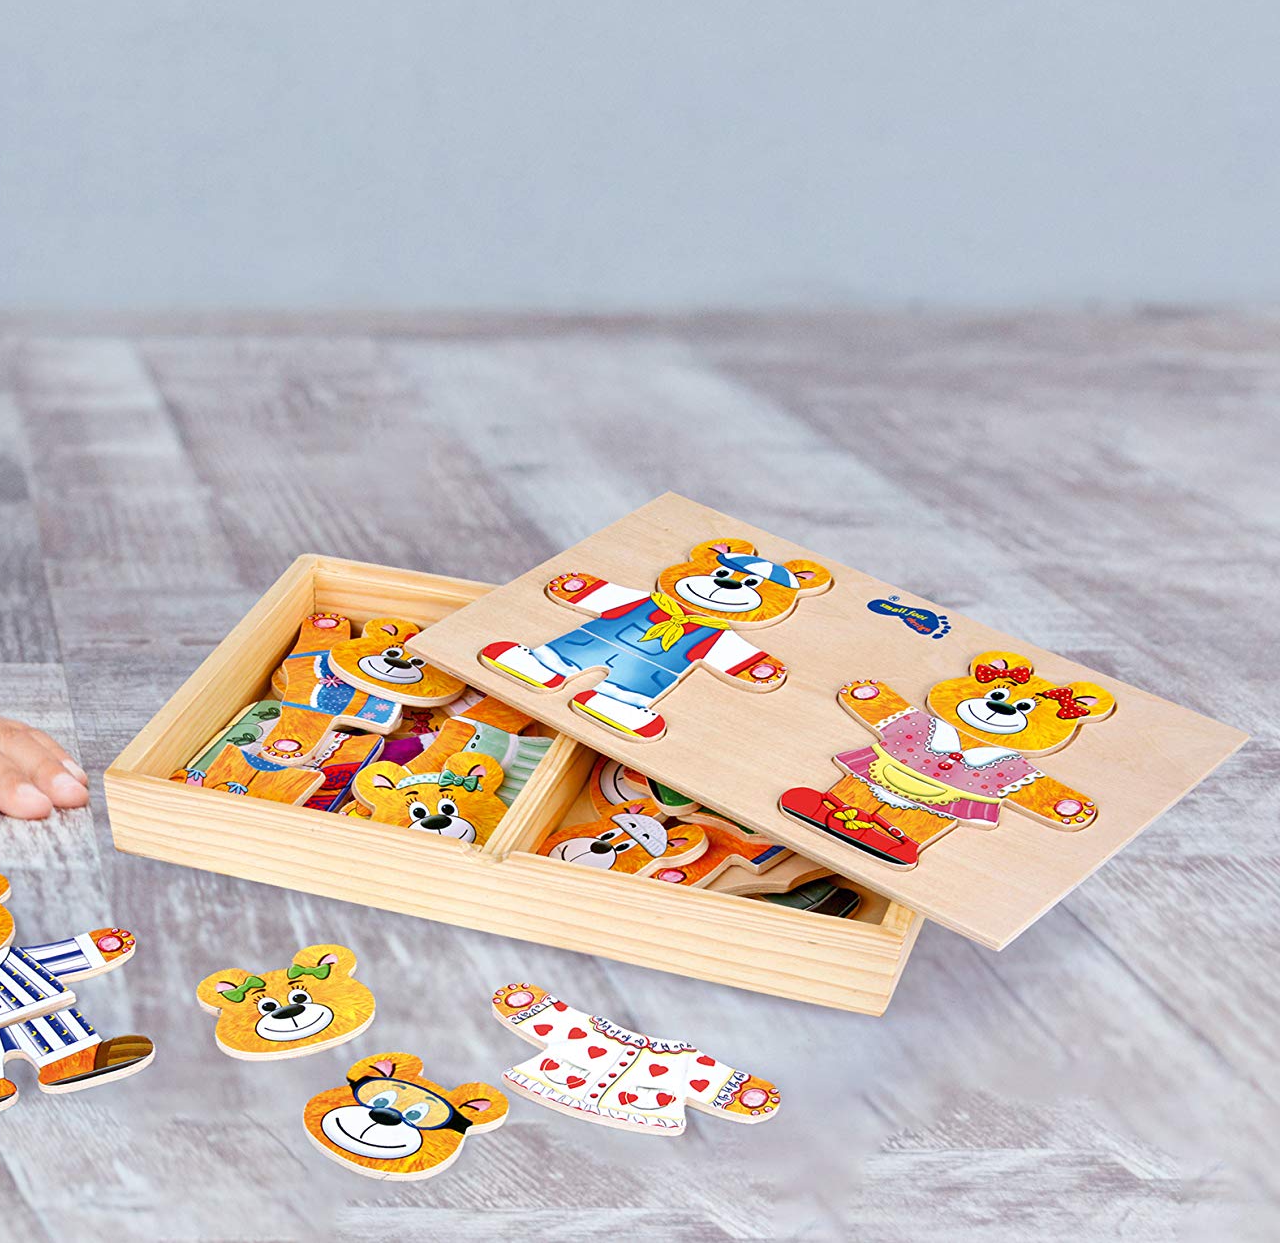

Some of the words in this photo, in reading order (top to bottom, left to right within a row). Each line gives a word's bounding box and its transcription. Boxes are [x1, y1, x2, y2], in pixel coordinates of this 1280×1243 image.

[880, 603, 908, 614] small
[904, 610, 928, 621] foot
[906, 617, 932, 633] design
